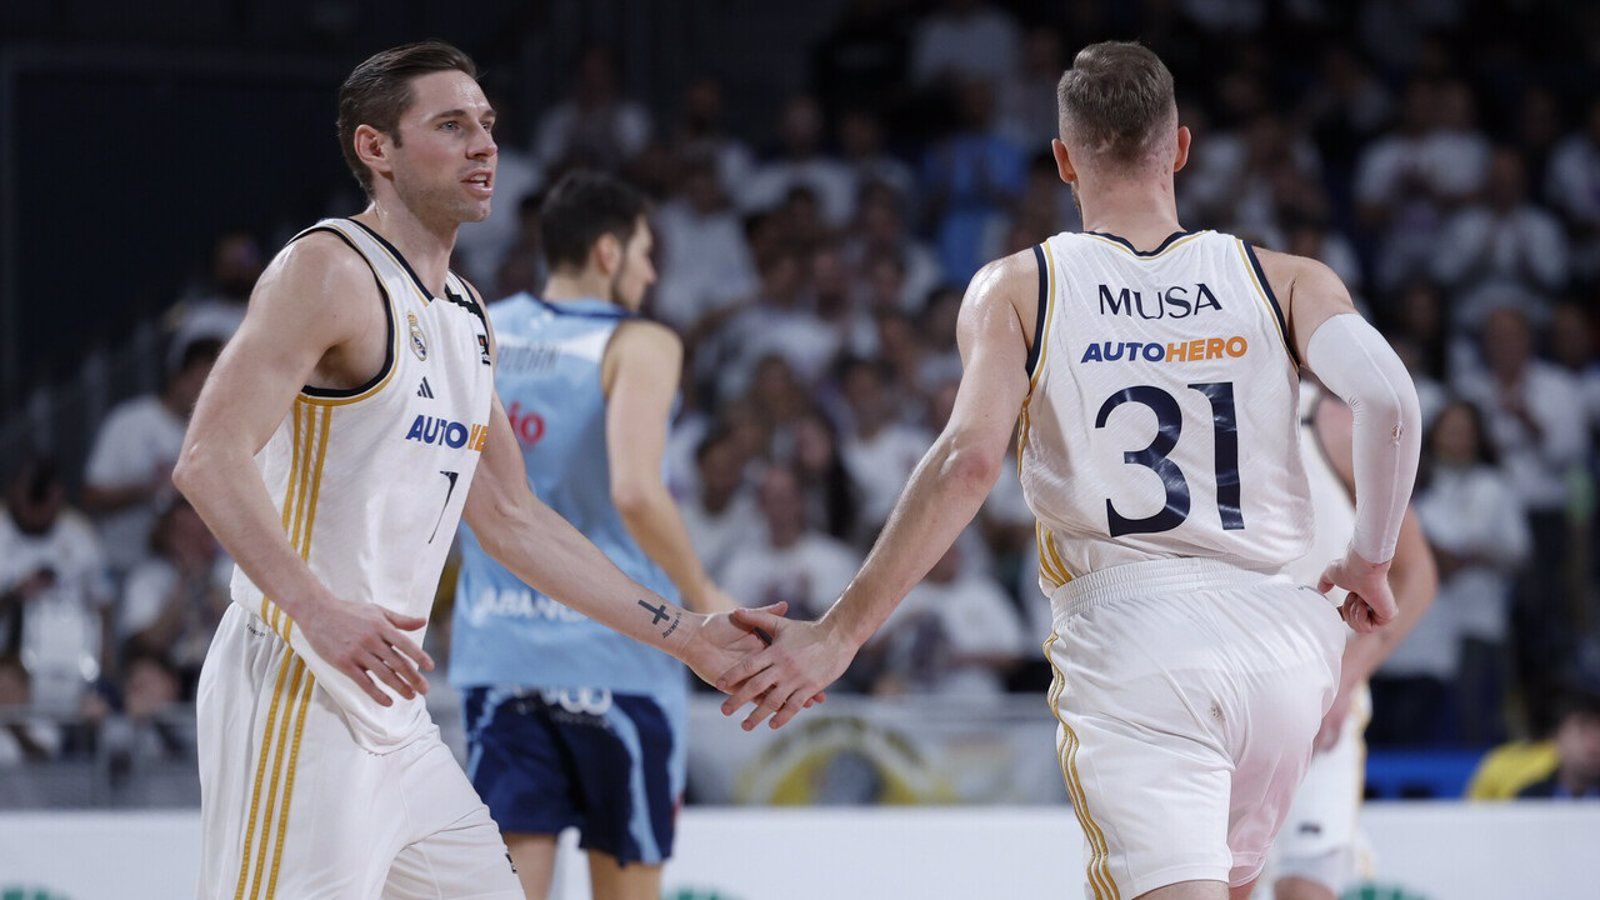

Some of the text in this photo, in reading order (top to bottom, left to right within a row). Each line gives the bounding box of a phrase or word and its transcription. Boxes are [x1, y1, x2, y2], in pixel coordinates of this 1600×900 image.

[1098, 283, 1222, 319] MUSA
[1081, 336, 1248, 363] AUTOHERO
[405, 414, 488, 452] AUTOHE
[1095, 382, 1244, 537] 31
